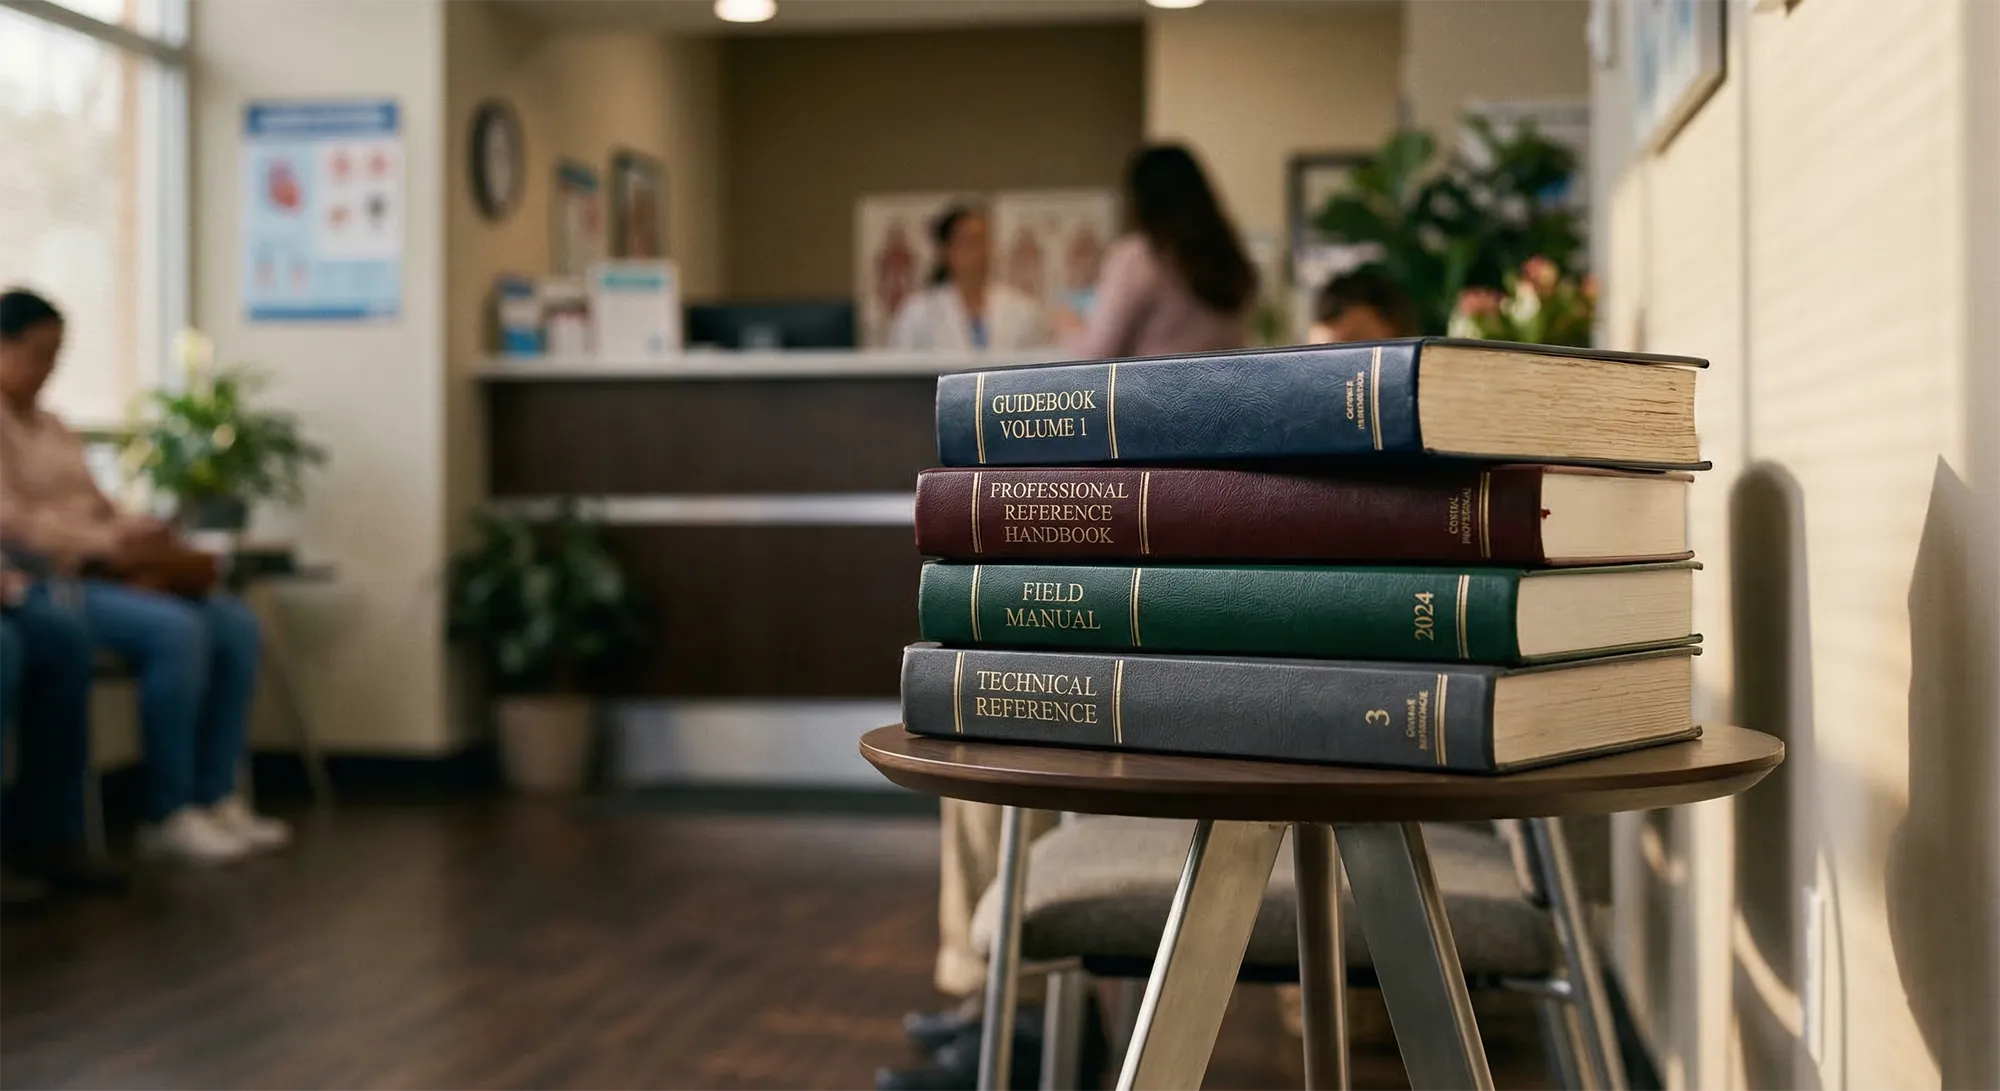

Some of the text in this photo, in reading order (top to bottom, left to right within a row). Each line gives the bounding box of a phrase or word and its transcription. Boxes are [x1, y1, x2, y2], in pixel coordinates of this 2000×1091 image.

[992, 389, 1097, 414] GUIDEBOOK
[1000, 417, 1087, 439] VOLUME 1
[990, 482, 1129, 499] PROFESSIONAL
[1004, 504, 1113, 521] REFERENCE
[1004, 526, 1114, 544] HANDBOOK
[1022, 581, 1084, 602] FIELD
[1005, 607, 1101, 630] MANUAL
[1414, 591, 1434, 642] 2024
[976, 670, 1097, 697] TECHNICAL
[975, 697, 1098, 724] REFERENCE
[1365, 709, 1390, 726] 3
